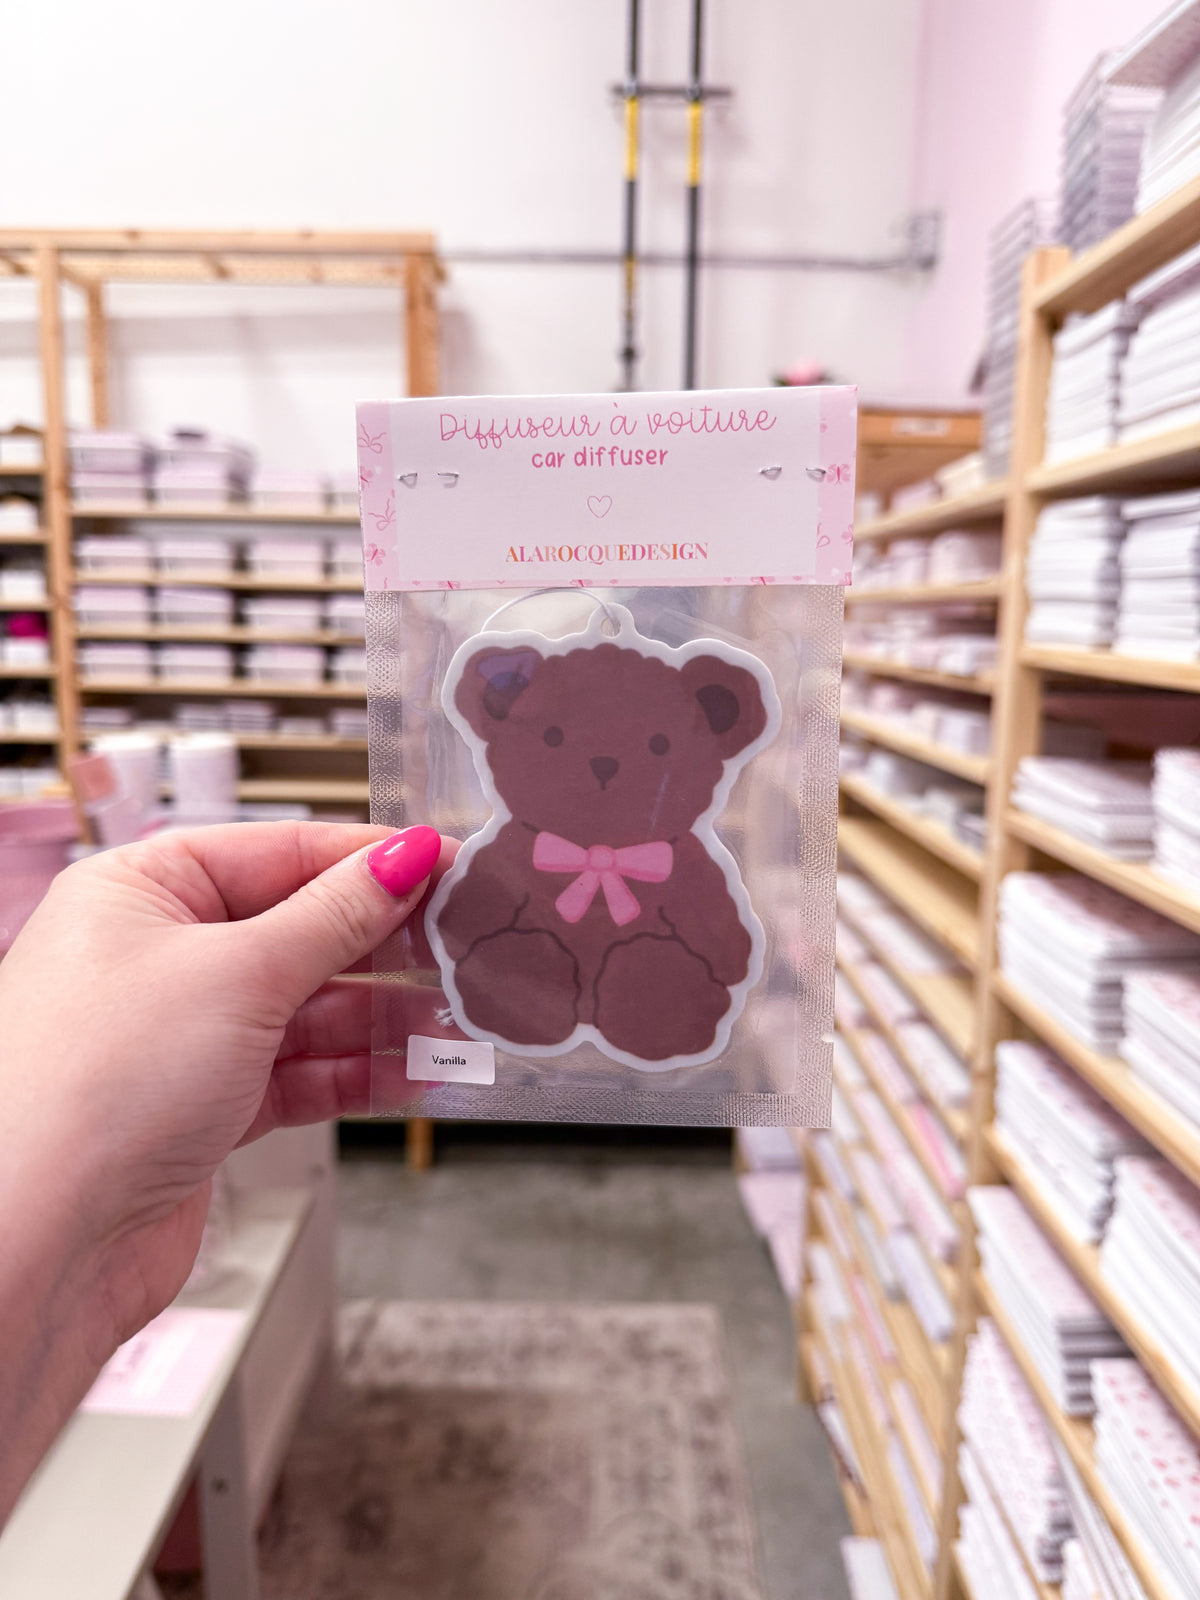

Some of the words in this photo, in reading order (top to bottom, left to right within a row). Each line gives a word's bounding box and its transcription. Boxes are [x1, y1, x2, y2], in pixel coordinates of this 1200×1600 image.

[440, 413, 600, 449] Diffuseur
[609, 401, 637, 437] à
[647, 405, 777, 435] voiture
[531, 449, 565, 469] car
[573, 445, 669, 468] diffuser
[505, 543, 708, 565] ALAROCQUEDESIGN
[432, 1055, 467, 1065] Vanilla
